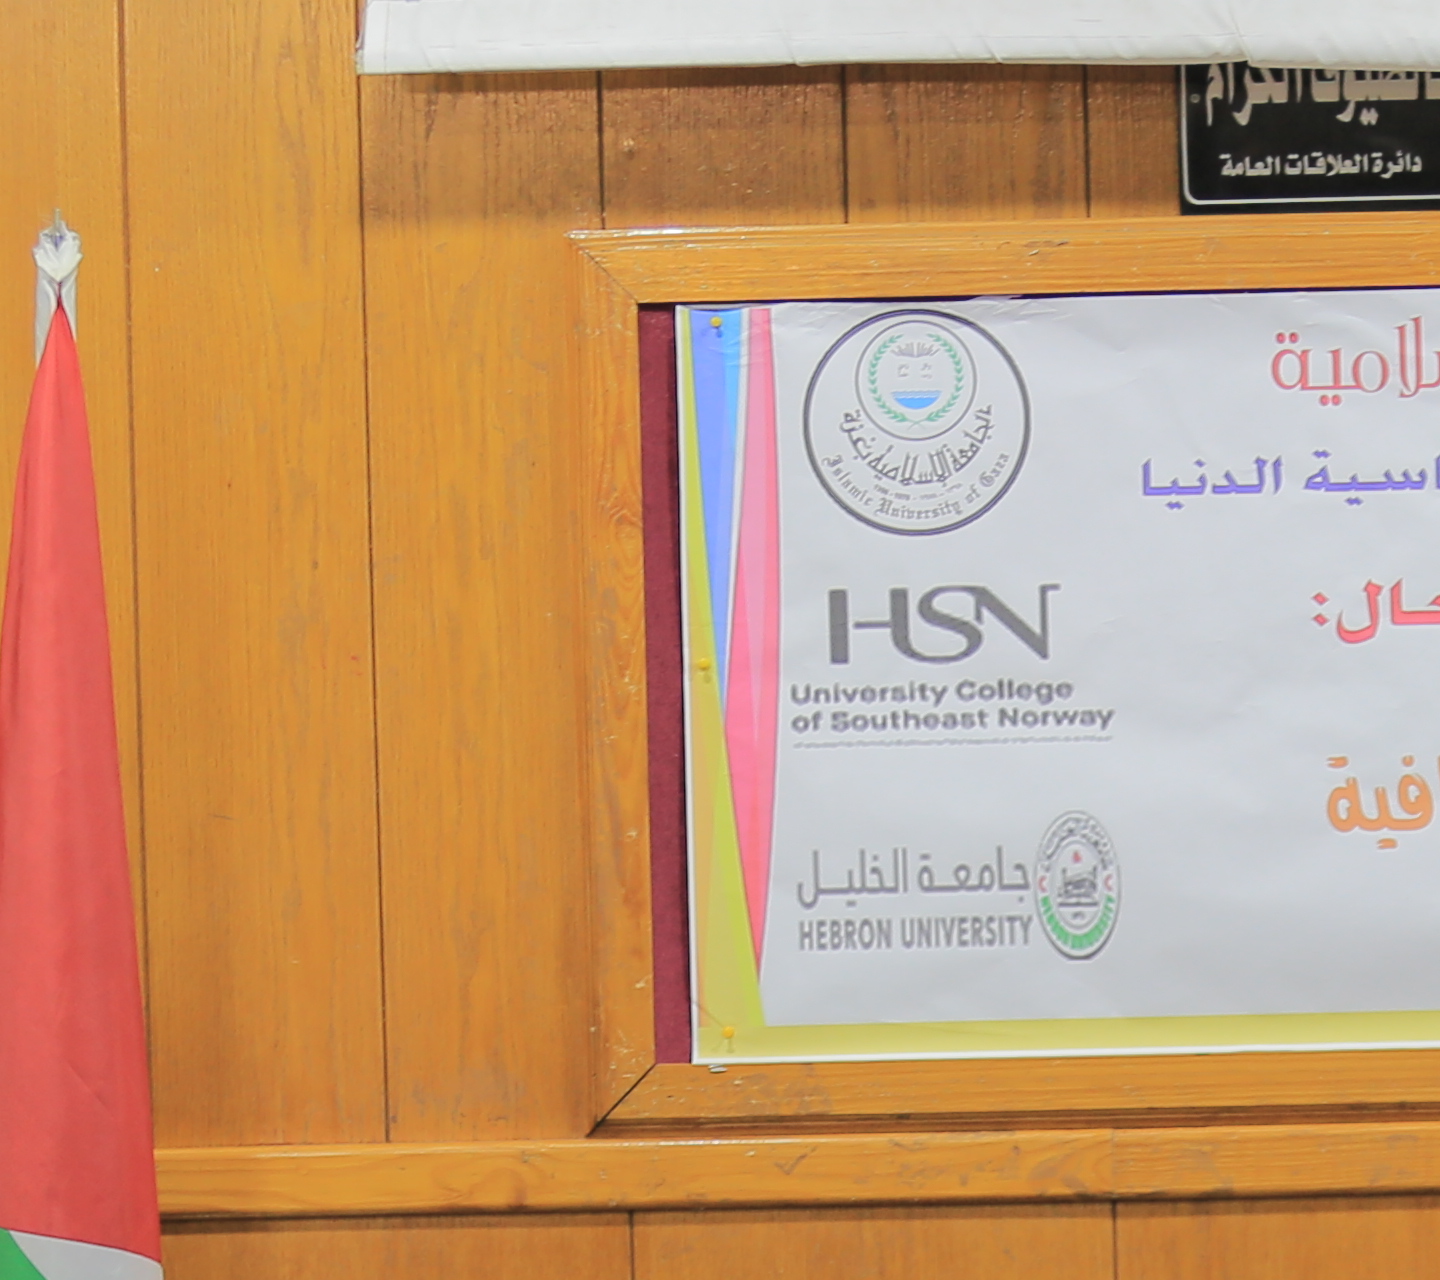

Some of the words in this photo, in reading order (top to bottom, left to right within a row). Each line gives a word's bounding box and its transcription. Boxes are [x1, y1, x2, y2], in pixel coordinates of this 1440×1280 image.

[1218, 152, 1282, 177] العامة
[1283, 151, 1369, 177] العلاقات
[1370, 149, 1423, 180] دائرة
[1142, 455, 1283, 510] الدنيا
[875, 498, 962, 519] University
[828, 583, 1060, 665] HSN
[790, 681, 948, 707] University
[955, 678, 1073, 705] College
[791, 710, 822, 733] of
[830, 709, 988, 733] Southeast
[998, 707, 1115, 731] Norway
[797, 847, 909, 910] الخليل
[917, 845, 1031, 903] جامعة
[795, 915, 894, 955] HEBRON
[898, 914, 1033, 951] UNIVERSITY
